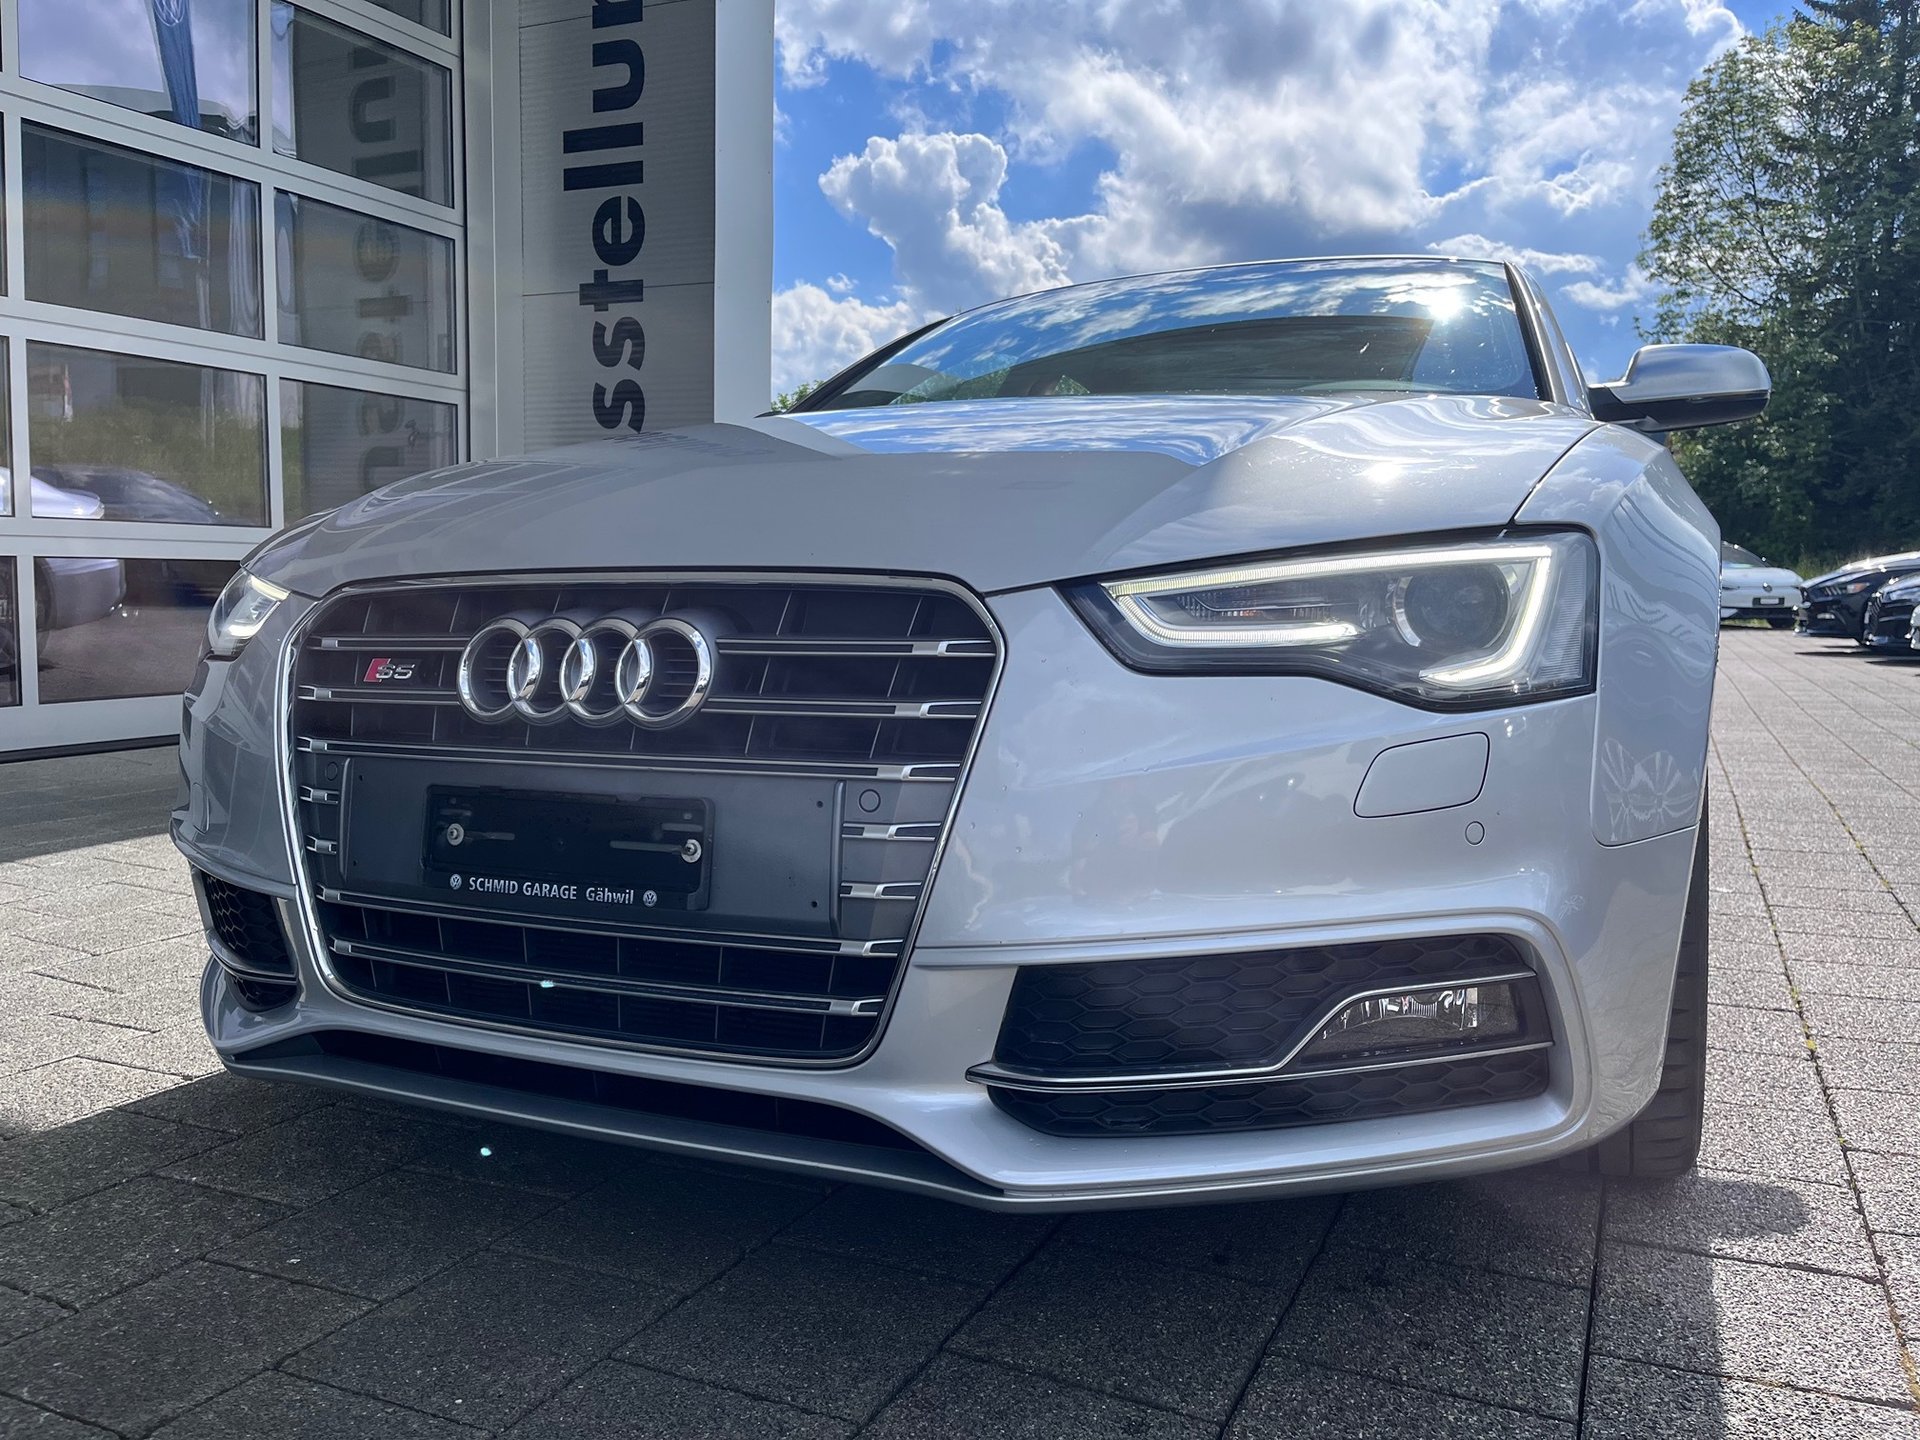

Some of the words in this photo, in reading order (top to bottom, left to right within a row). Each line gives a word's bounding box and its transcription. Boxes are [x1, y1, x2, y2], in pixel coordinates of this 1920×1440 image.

[375, 663, 416, 680] S5
[468, 876, 519, 895] SCHMID
[522, 881, 578, 900] GARAGE
[585, 887, 634, 905] Gähwil
